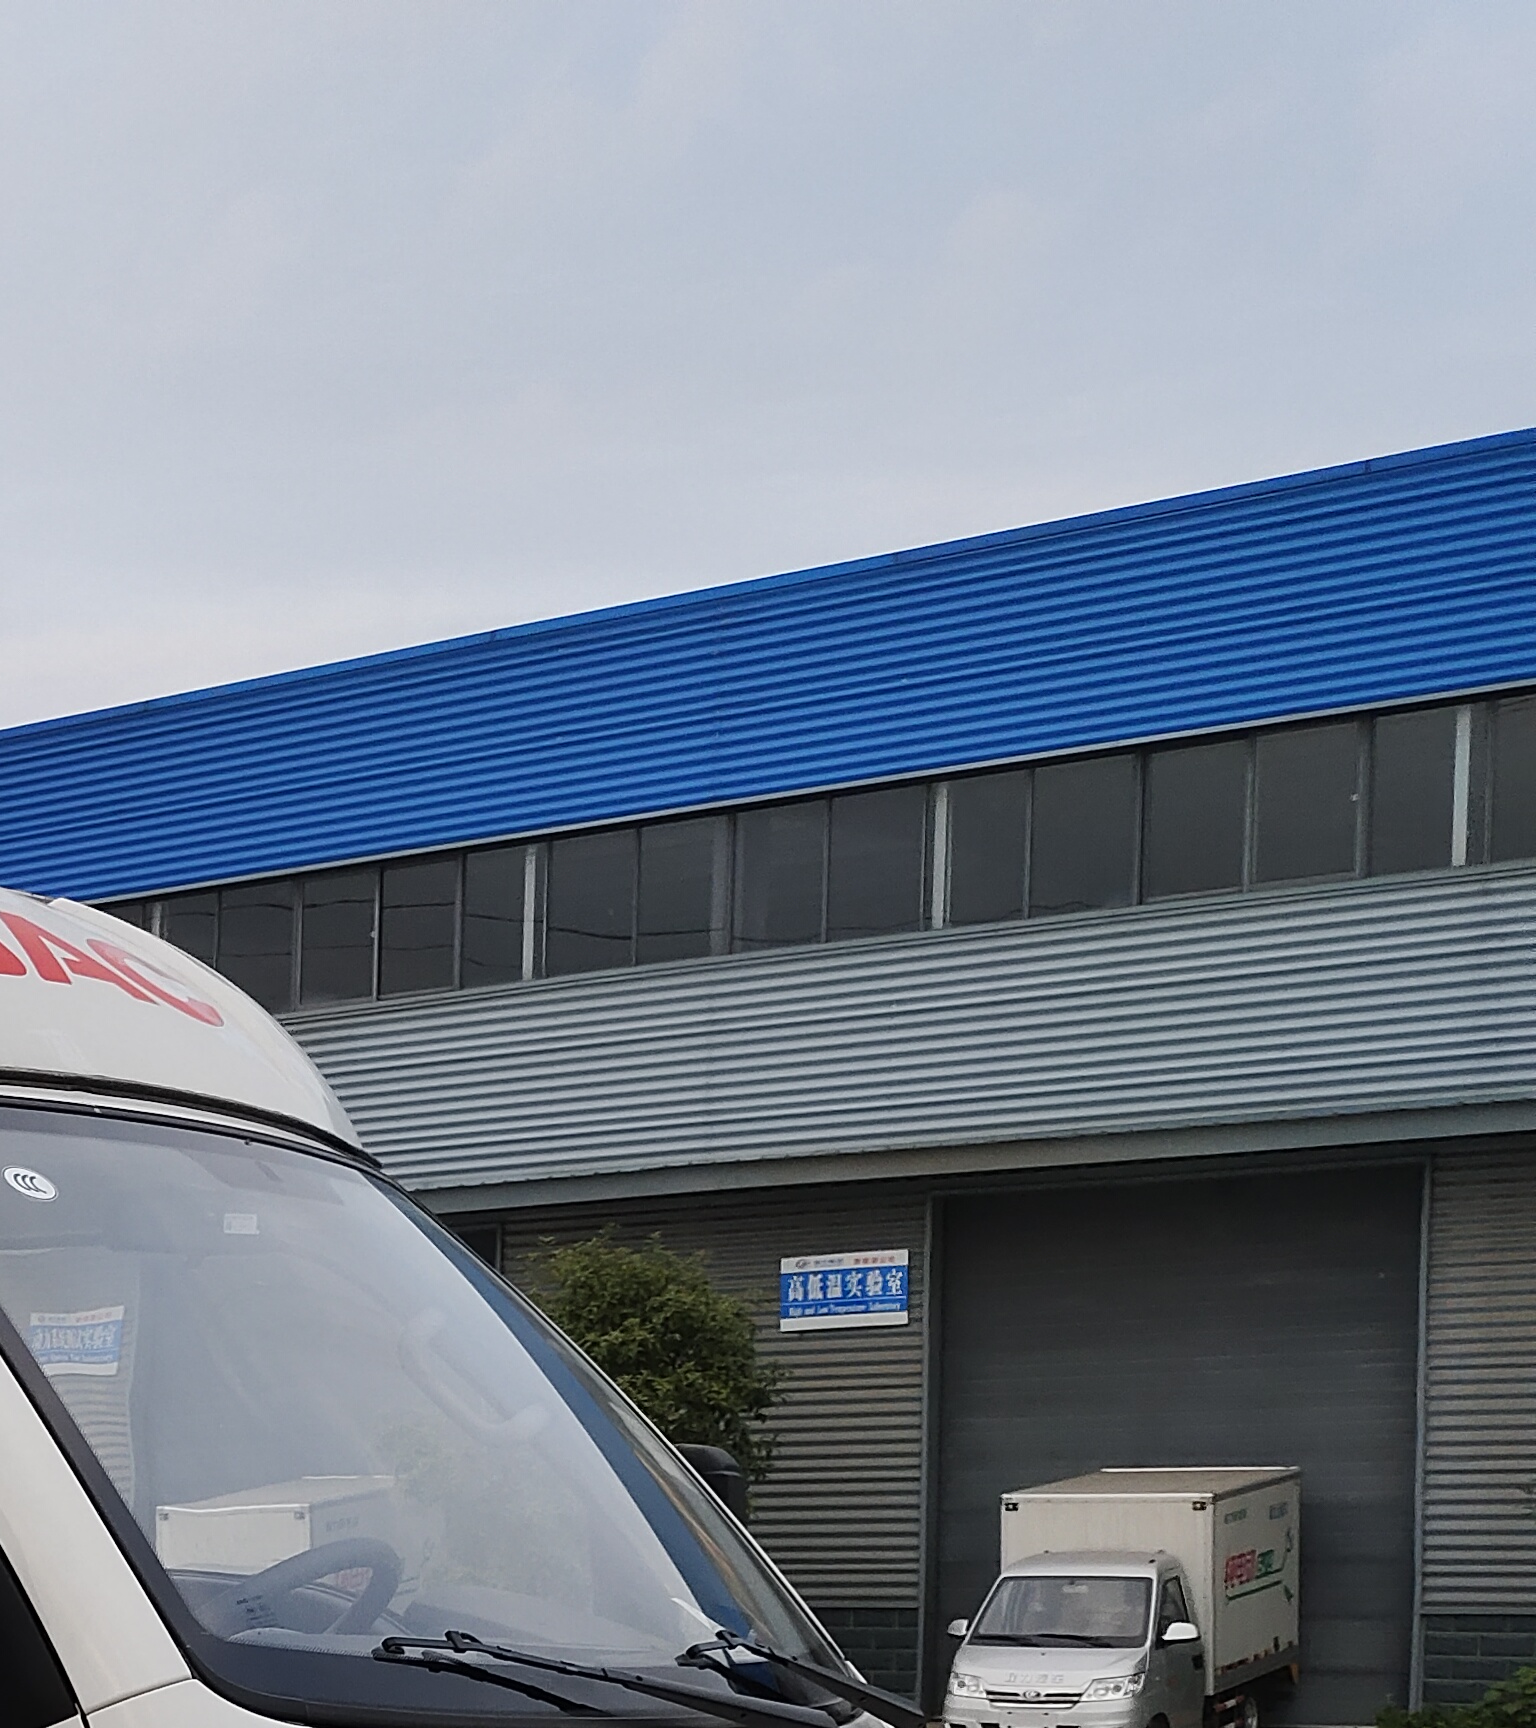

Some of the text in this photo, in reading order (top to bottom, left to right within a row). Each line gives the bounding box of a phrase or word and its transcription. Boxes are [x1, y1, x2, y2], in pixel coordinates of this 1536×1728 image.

[787, 1267, 904, 1302] 高低温实验室
